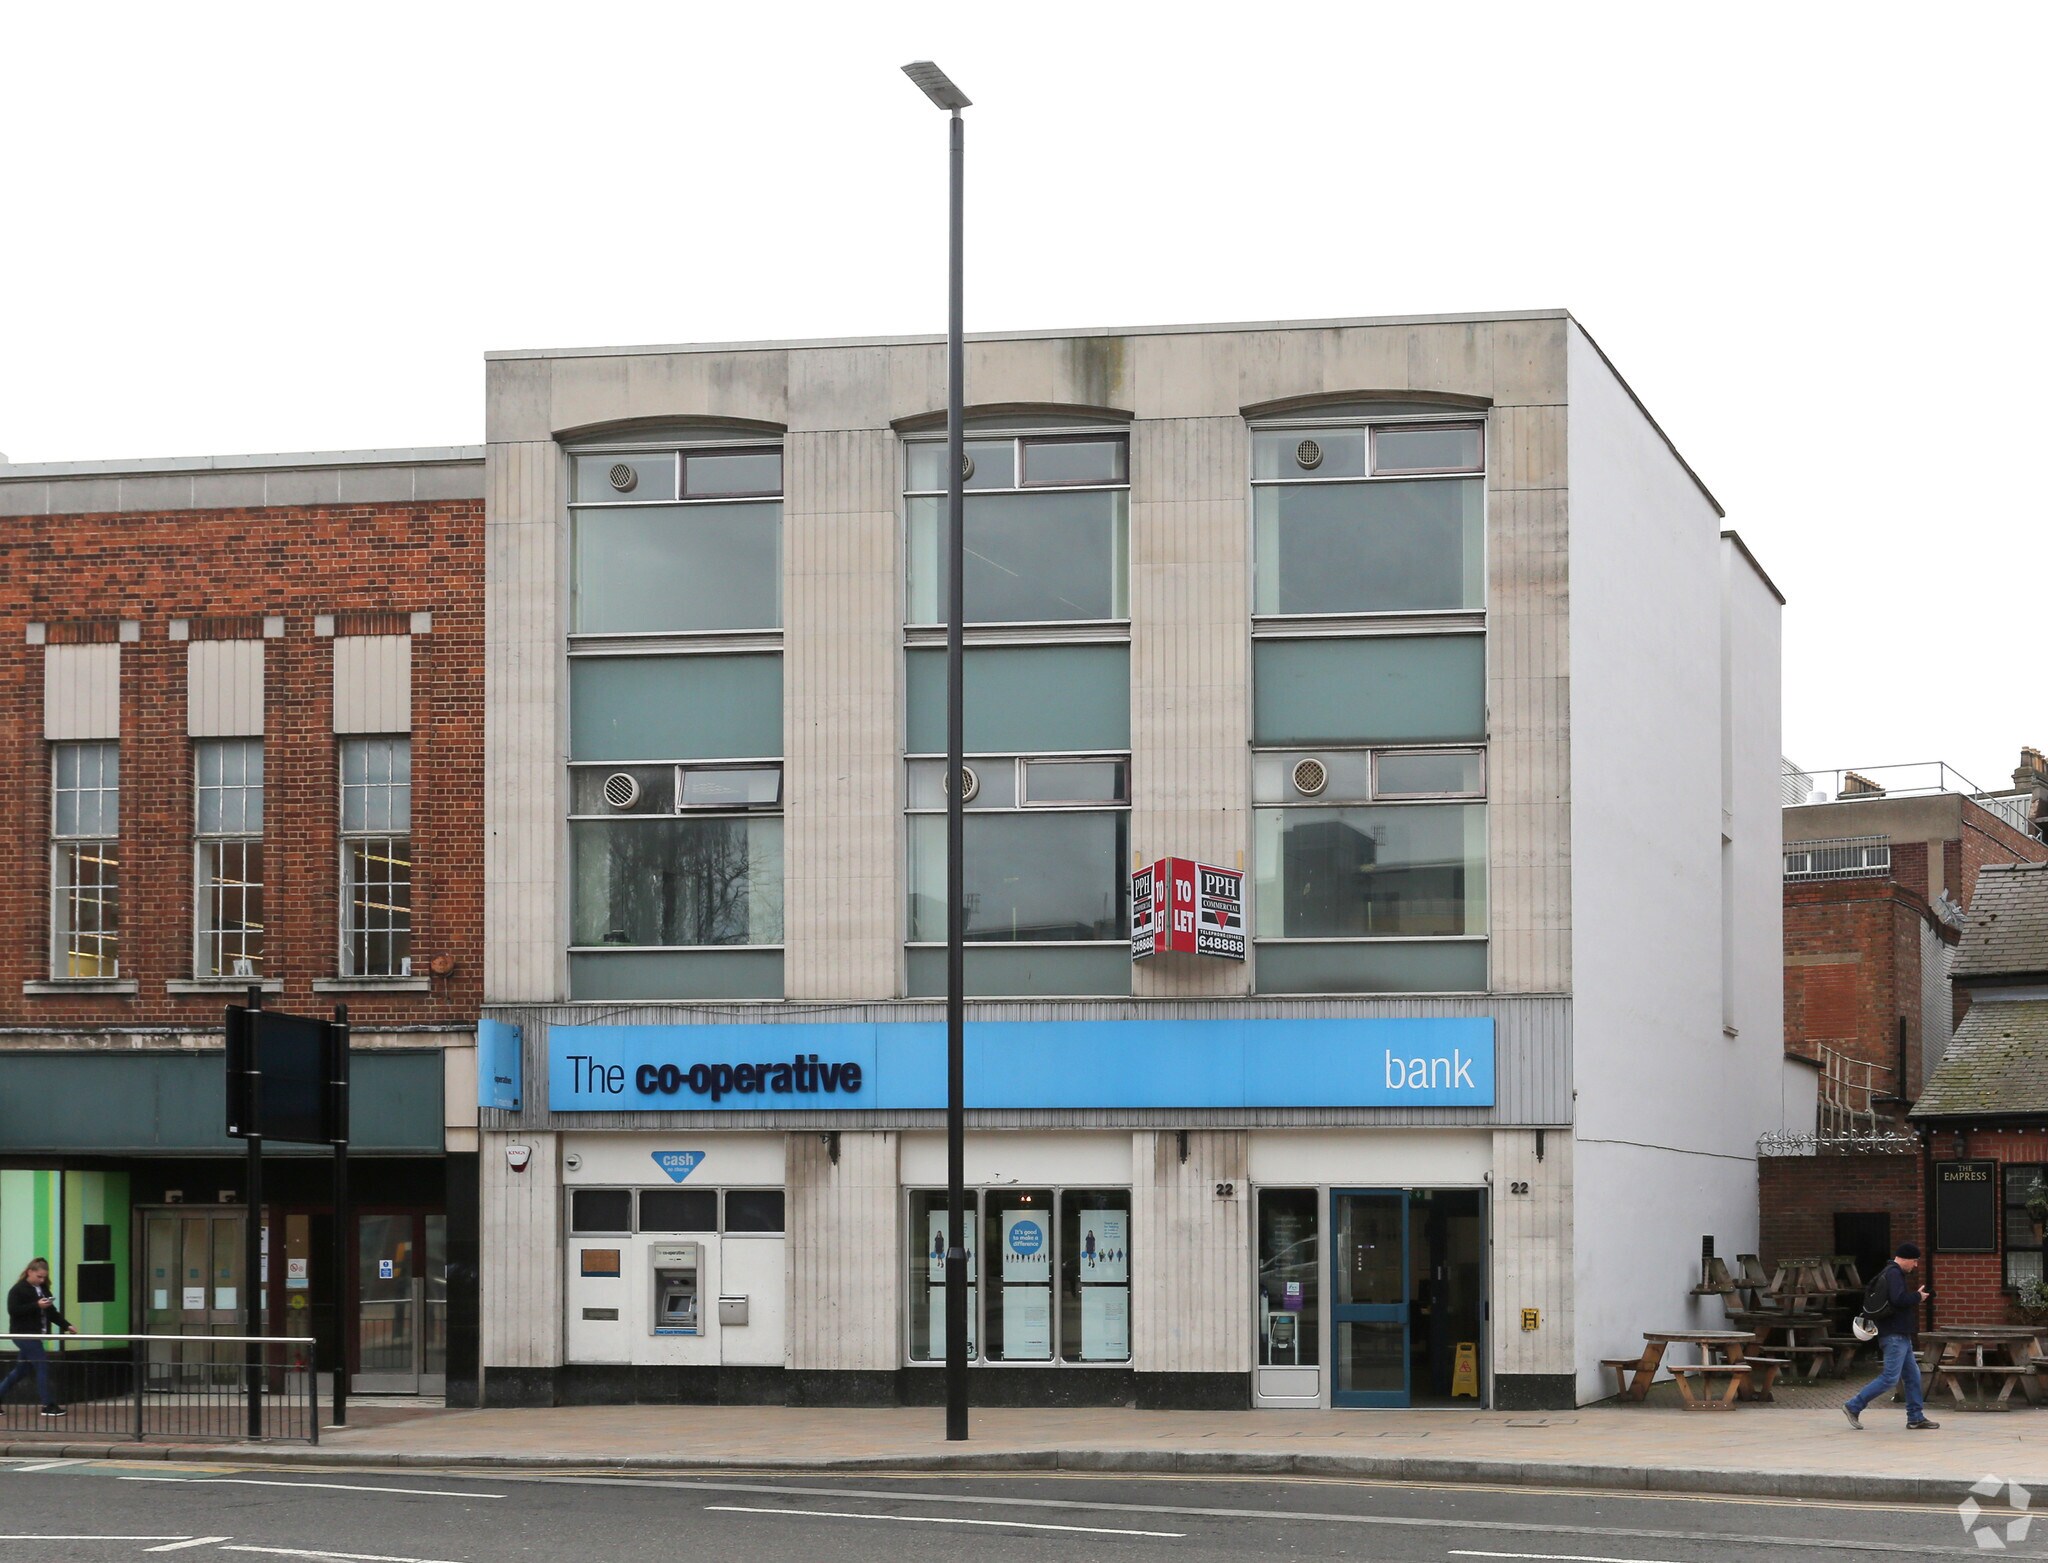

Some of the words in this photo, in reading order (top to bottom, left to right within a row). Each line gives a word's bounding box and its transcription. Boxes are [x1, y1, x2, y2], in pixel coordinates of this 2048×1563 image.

[1135, 874, 1150, 898] PPH
[1155, 880, 1164, 904] TO
[1175, 879, 1192, 903] TO
[1205, 873, 1237, 898] PPH
[1202, 899, 1239, 913] COMMERCIAL
[1155, 909, 1165, 934] LET
[1174, 909, 1194, 934] LET
[1198, 935, 1244, 953] 648888
[566, 1055, 625, 1095] The
[635, 1053, 863, 1103] co-operative
[1385, 1048, 1476, 1089] bank
[662, 1152, 694, 1166] cash
[1510, 1182, 1529, 1194] 22
[1944, 1172, 1987, 1181] EMPRESS
[1215, 1183, 1234, 1196] 22
[1524, 1311, 1537, 1328] H
